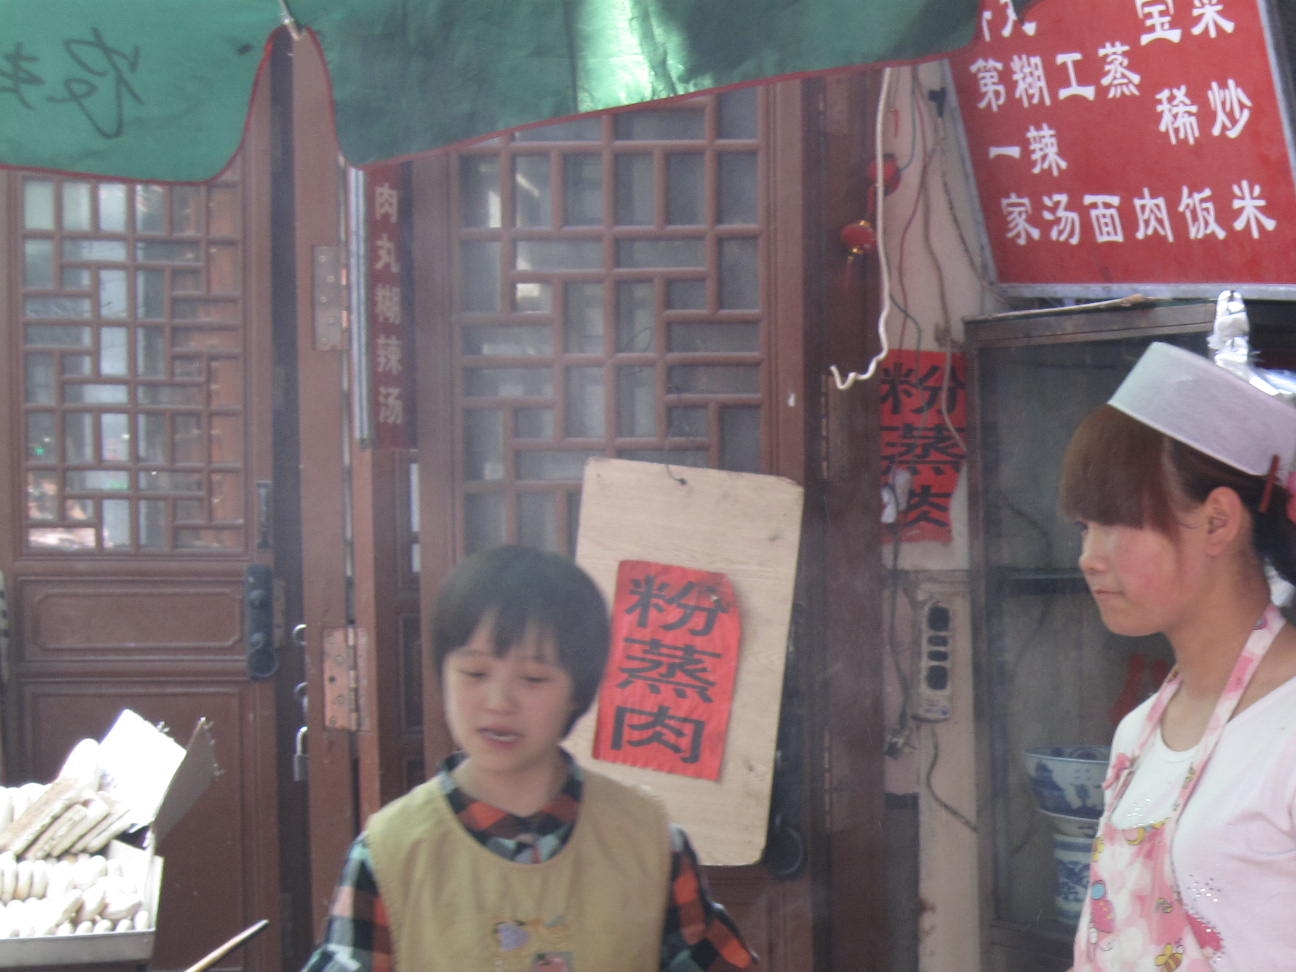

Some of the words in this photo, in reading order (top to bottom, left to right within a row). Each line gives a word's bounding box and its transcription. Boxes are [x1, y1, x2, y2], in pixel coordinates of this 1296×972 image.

[374, 182, 404, 425] 肉丸糊辣汤
[609, 574, 730, 764] 粉蒸肉
